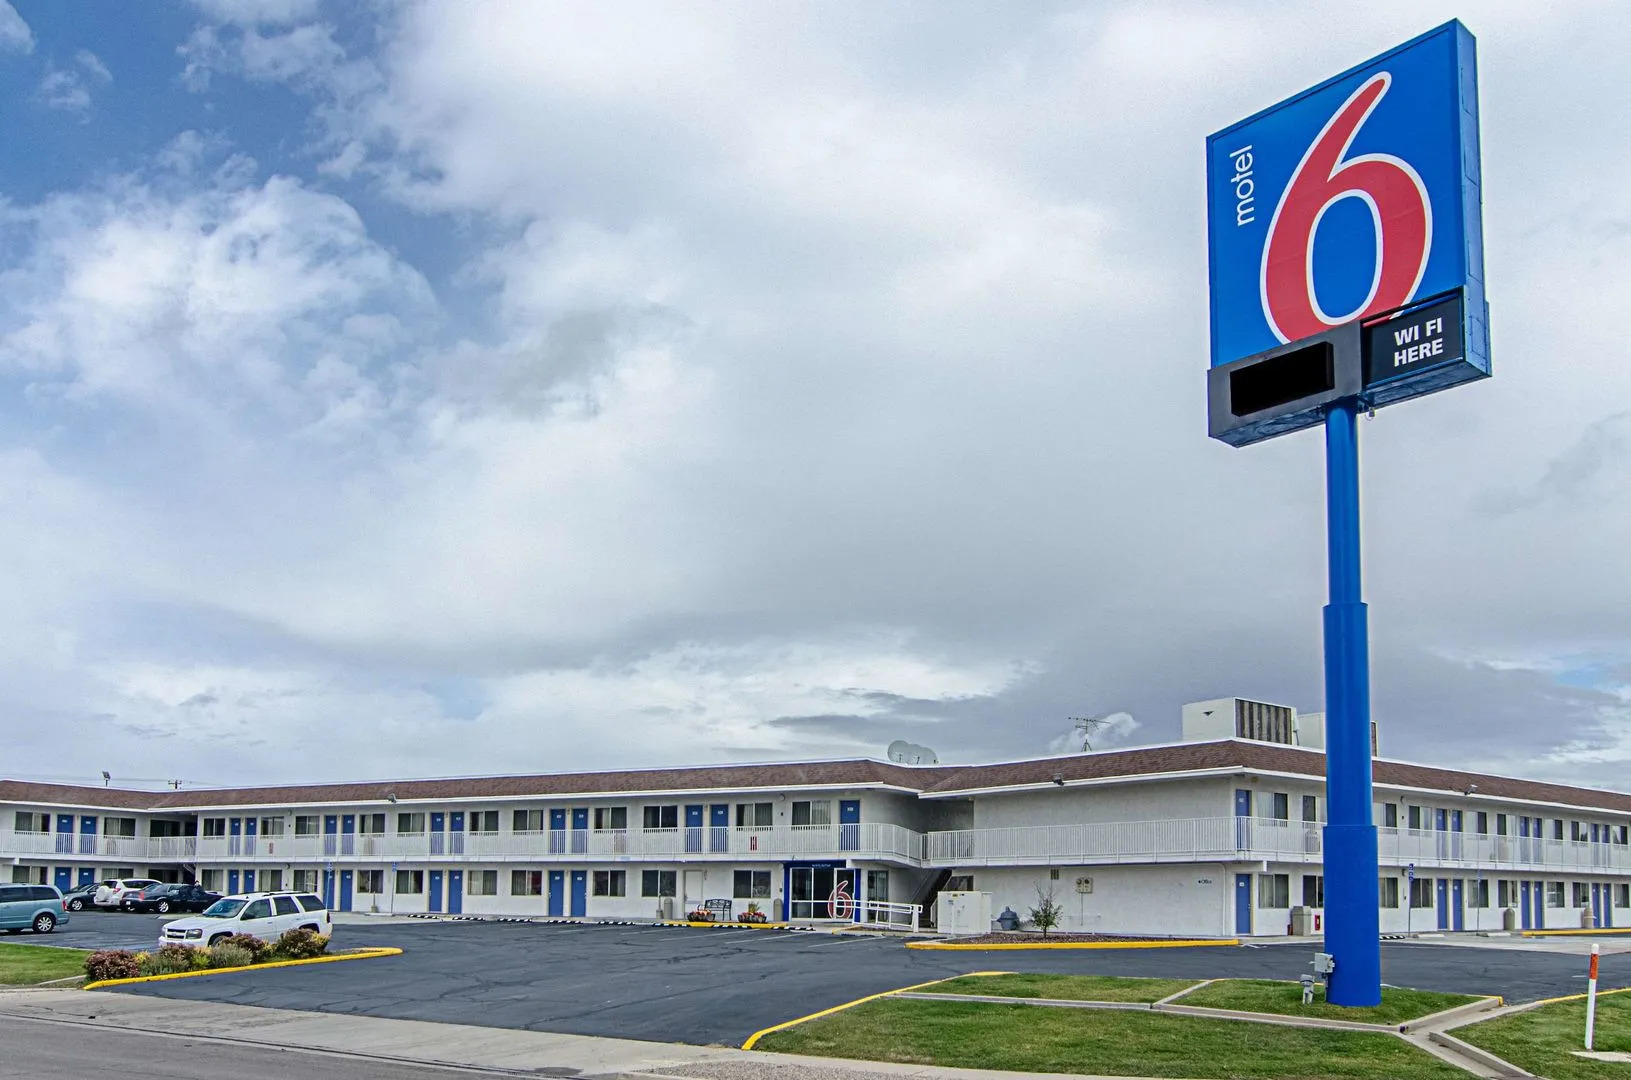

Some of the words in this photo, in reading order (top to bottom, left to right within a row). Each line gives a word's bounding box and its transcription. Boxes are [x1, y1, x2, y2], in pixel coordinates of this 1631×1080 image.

[1229, 144, 1255, 227] motel
[1259, 70, 1433, 345] 6
[1393, 325, 1420, 347] WI
[1425, 317, 1443, 337] FI
[1393, 338, 1444, 368] HERE
[827, 880, 853, 920] 6
